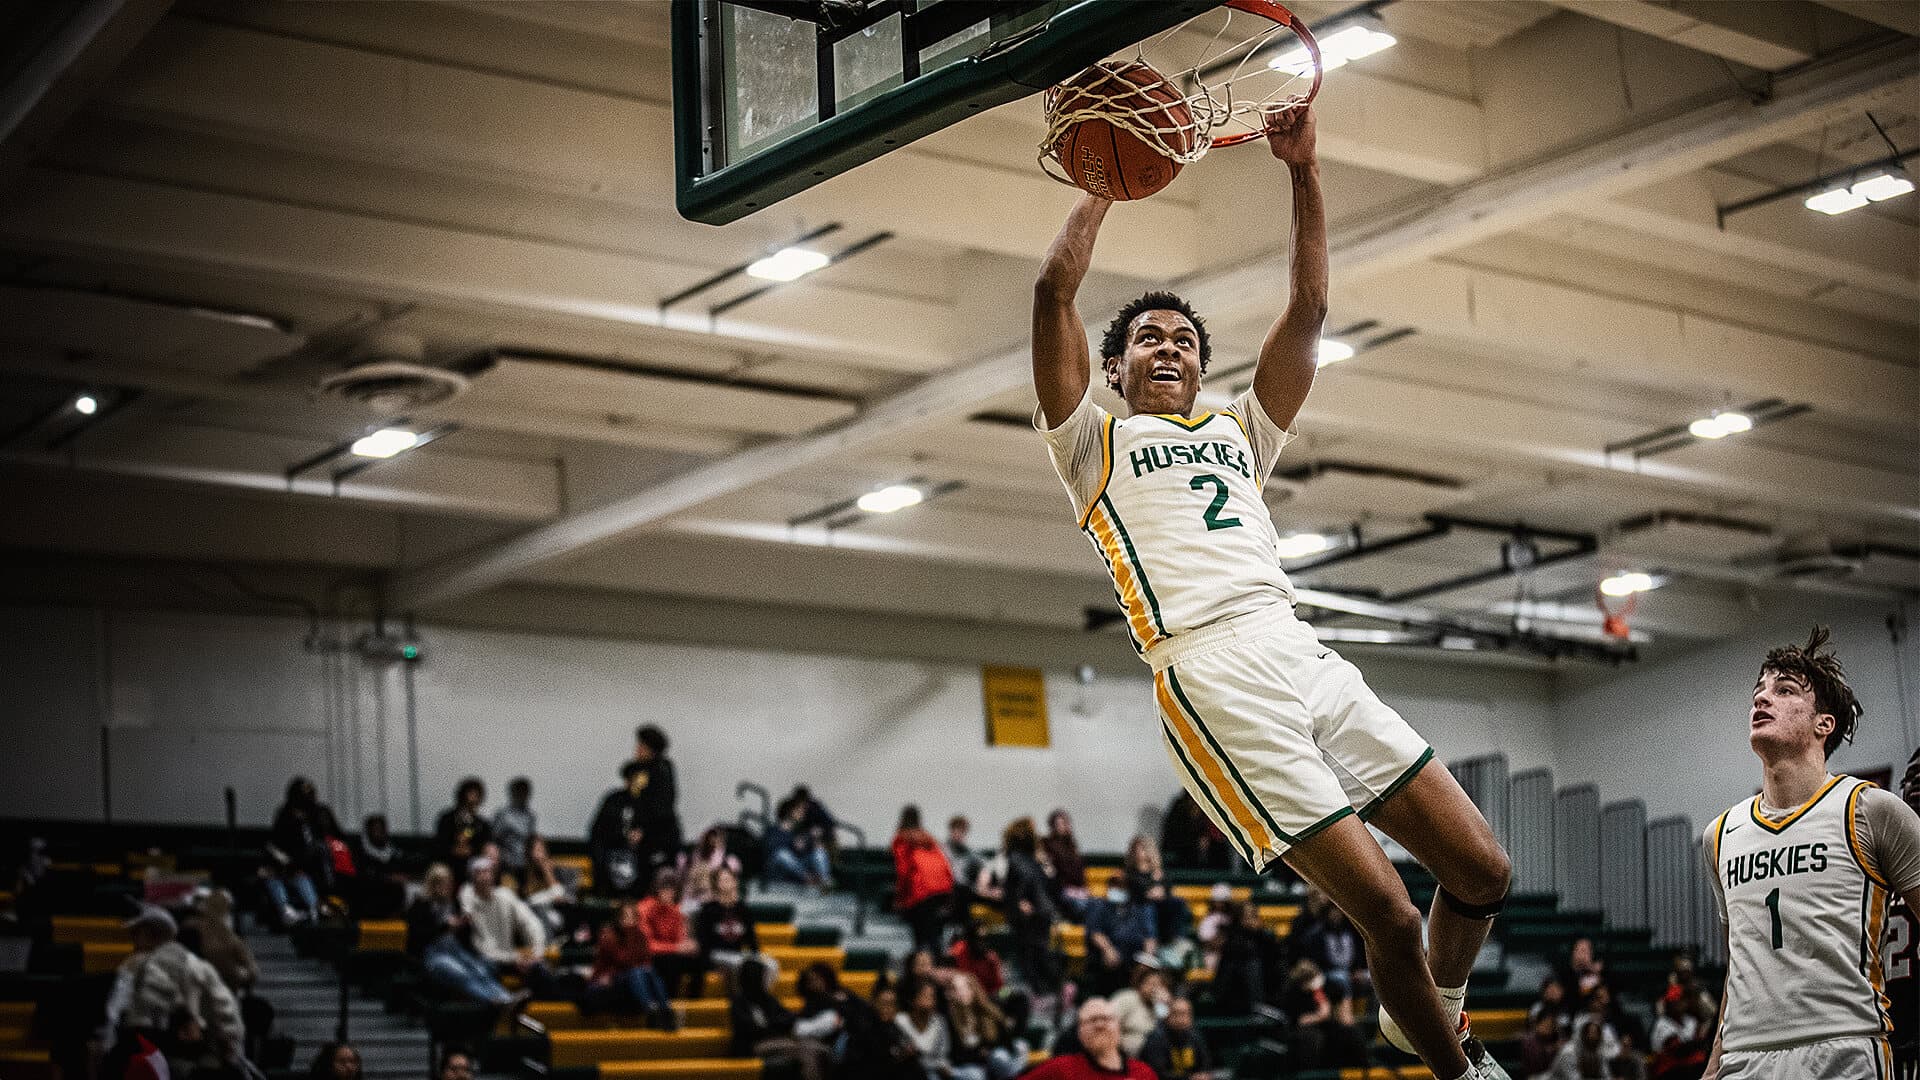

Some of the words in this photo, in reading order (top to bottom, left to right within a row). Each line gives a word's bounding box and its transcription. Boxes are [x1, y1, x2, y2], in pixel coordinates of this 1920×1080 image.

[1130, 442, 1250, 478] HUSKIES
[1189, 474, 1243, 531] 2
[1727, 843, 1828, 889] HUSKIES
[1765, 888, 1783, 950] 1
